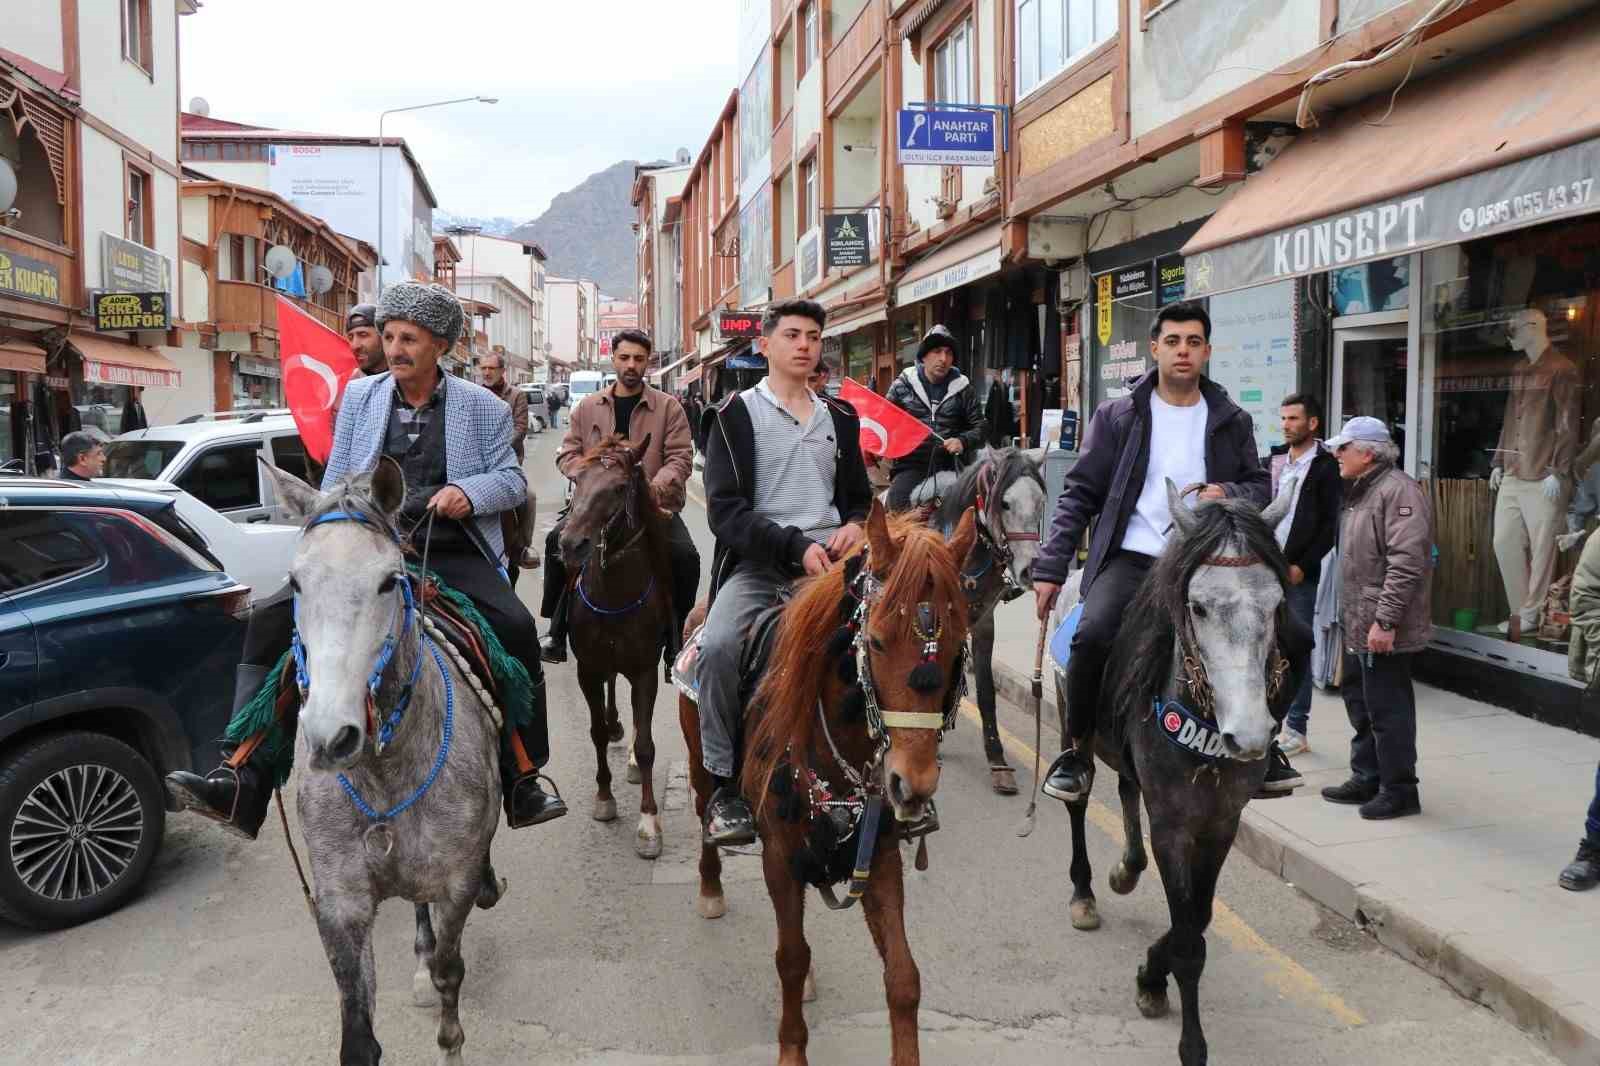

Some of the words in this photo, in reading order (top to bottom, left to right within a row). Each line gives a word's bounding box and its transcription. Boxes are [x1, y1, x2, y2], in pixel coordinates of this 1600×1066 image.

[933, 120, 989, 132] ANAHTAR
[292, 146, 320, 155] BOSCH
[1273, 197, 1425, 275] KONSEPT
[1571, 178, 1594, 205] 37
[15, 266, 58, 300] KUAFÖR
[100, 311, 164, 329] KUAFÖR
